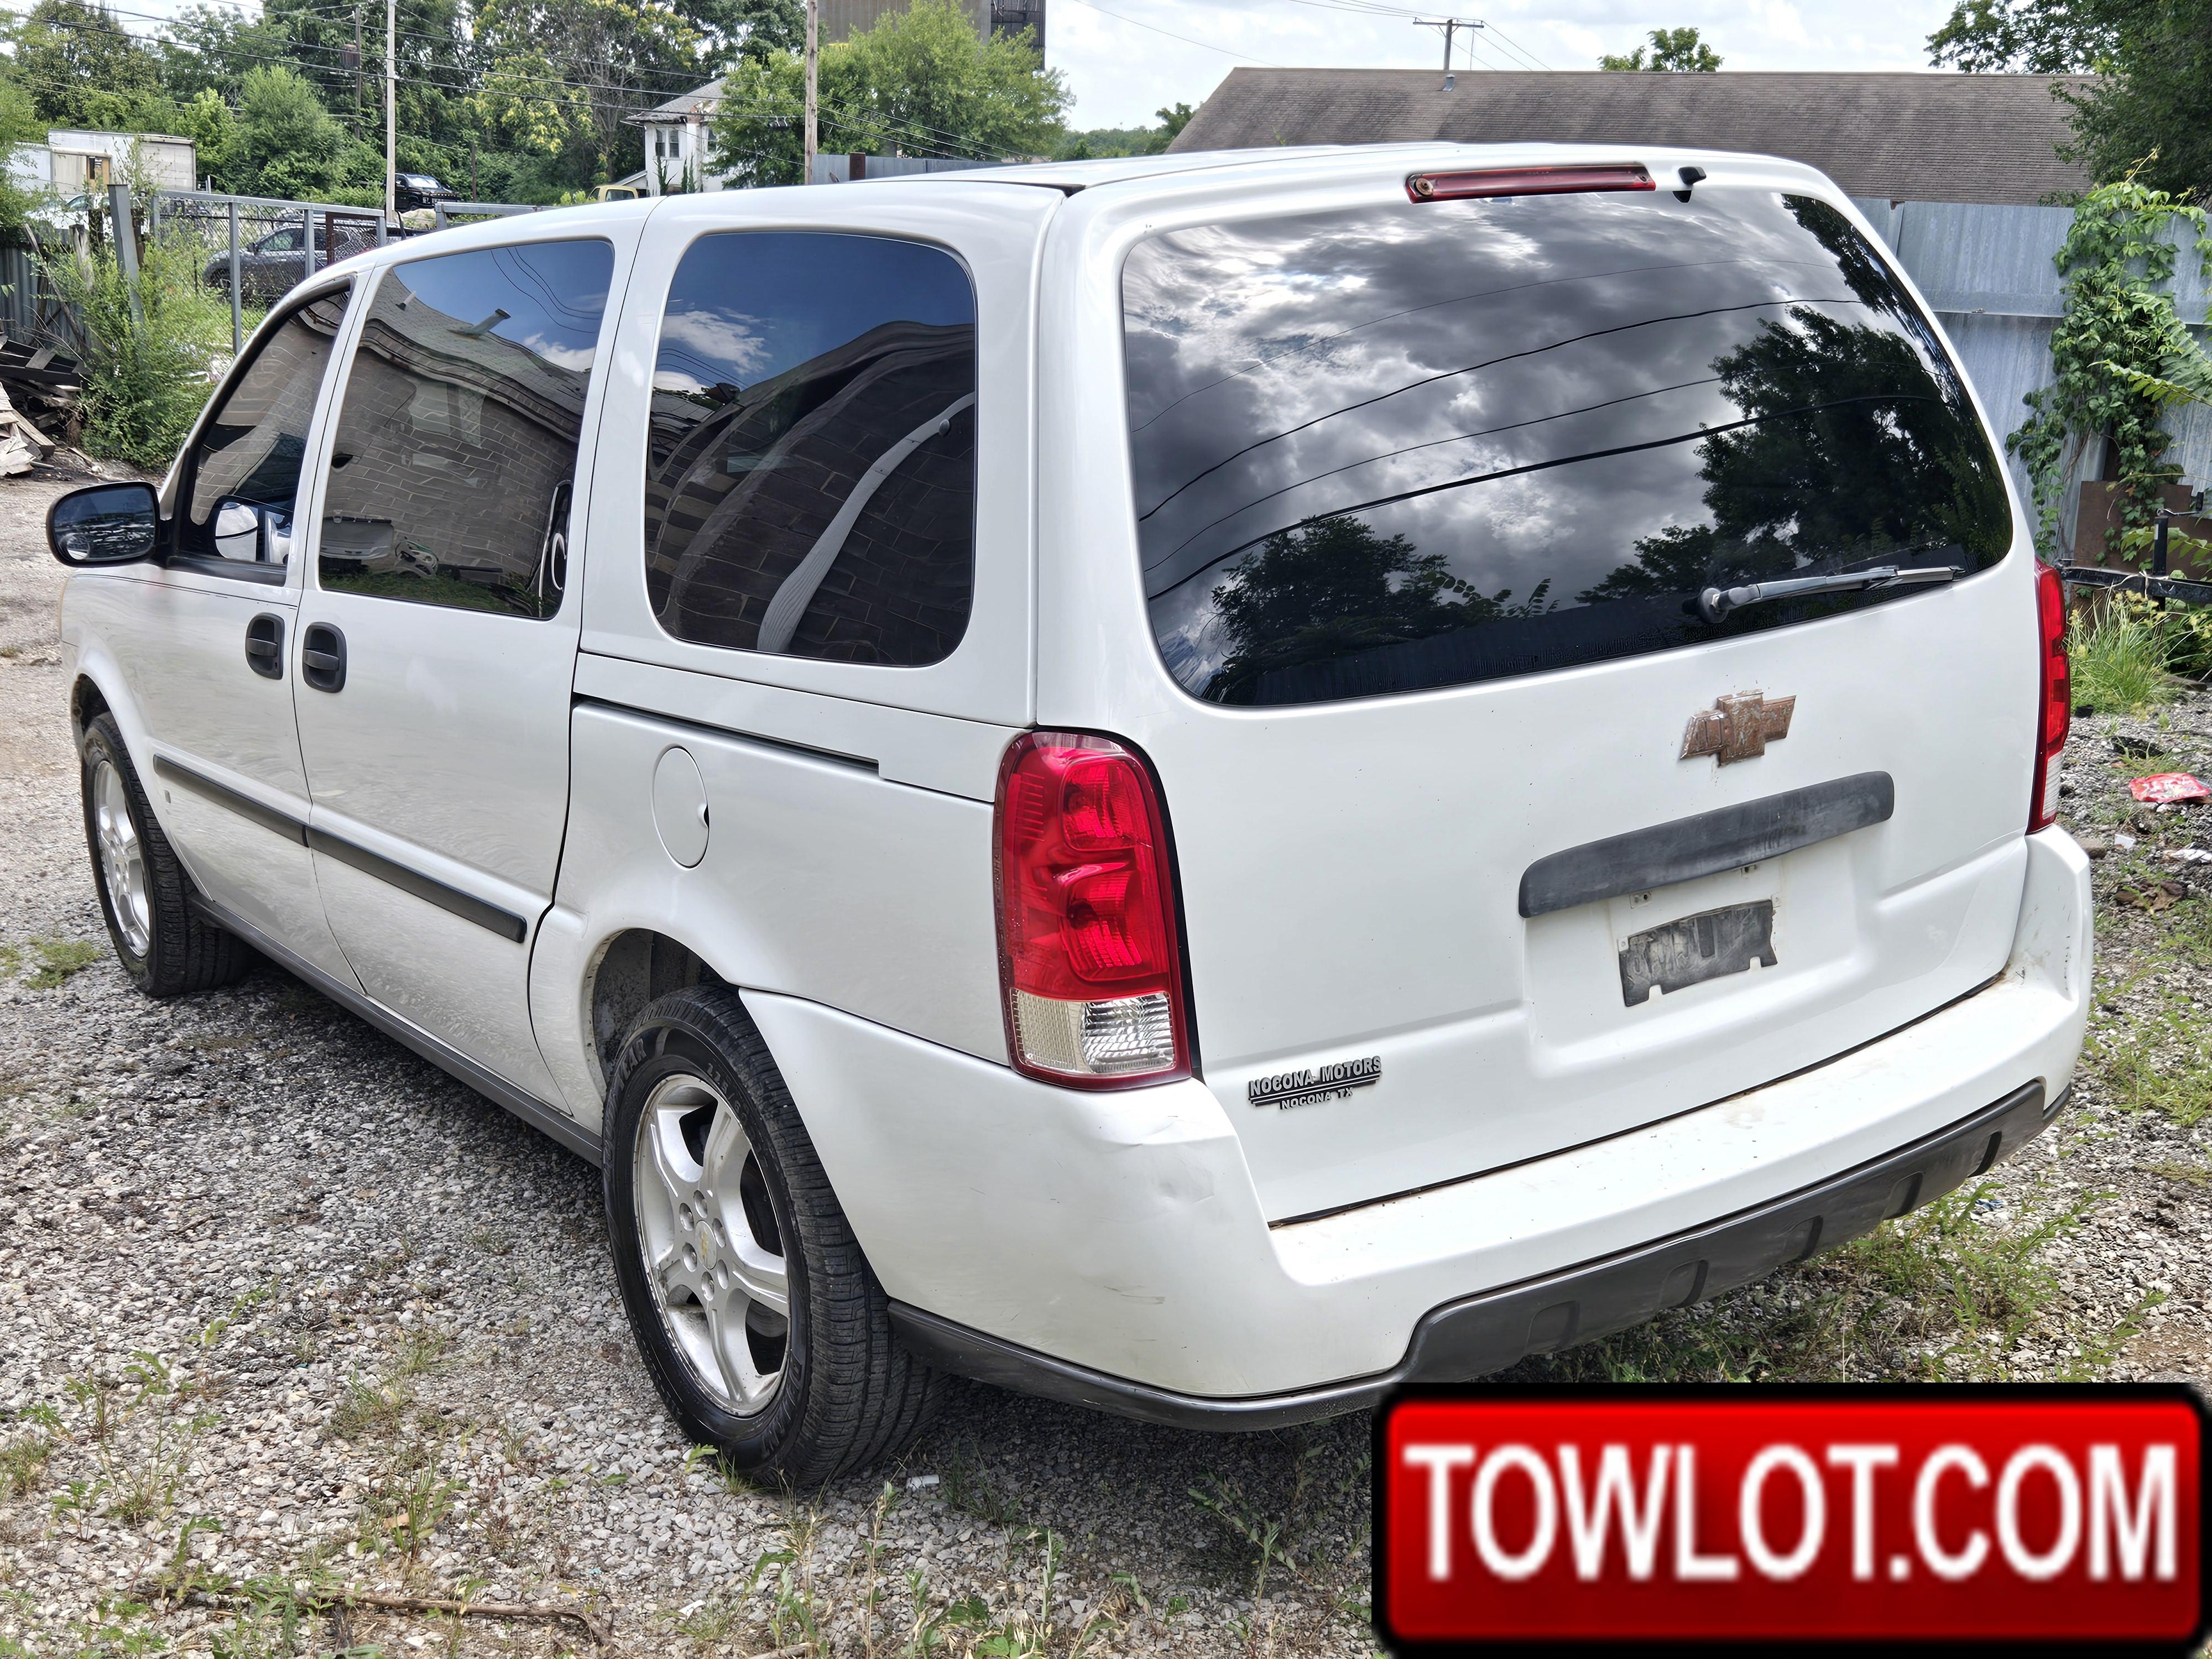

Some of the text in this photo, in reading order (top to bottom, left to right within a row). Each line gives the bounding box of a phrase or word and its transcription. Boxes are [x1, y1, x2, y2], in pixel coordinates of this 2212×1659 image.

[1248, 1056, 1382, 1096] NOCONA MOTORS
[1280, 1087, 1354, 1109] NOCONA TX
